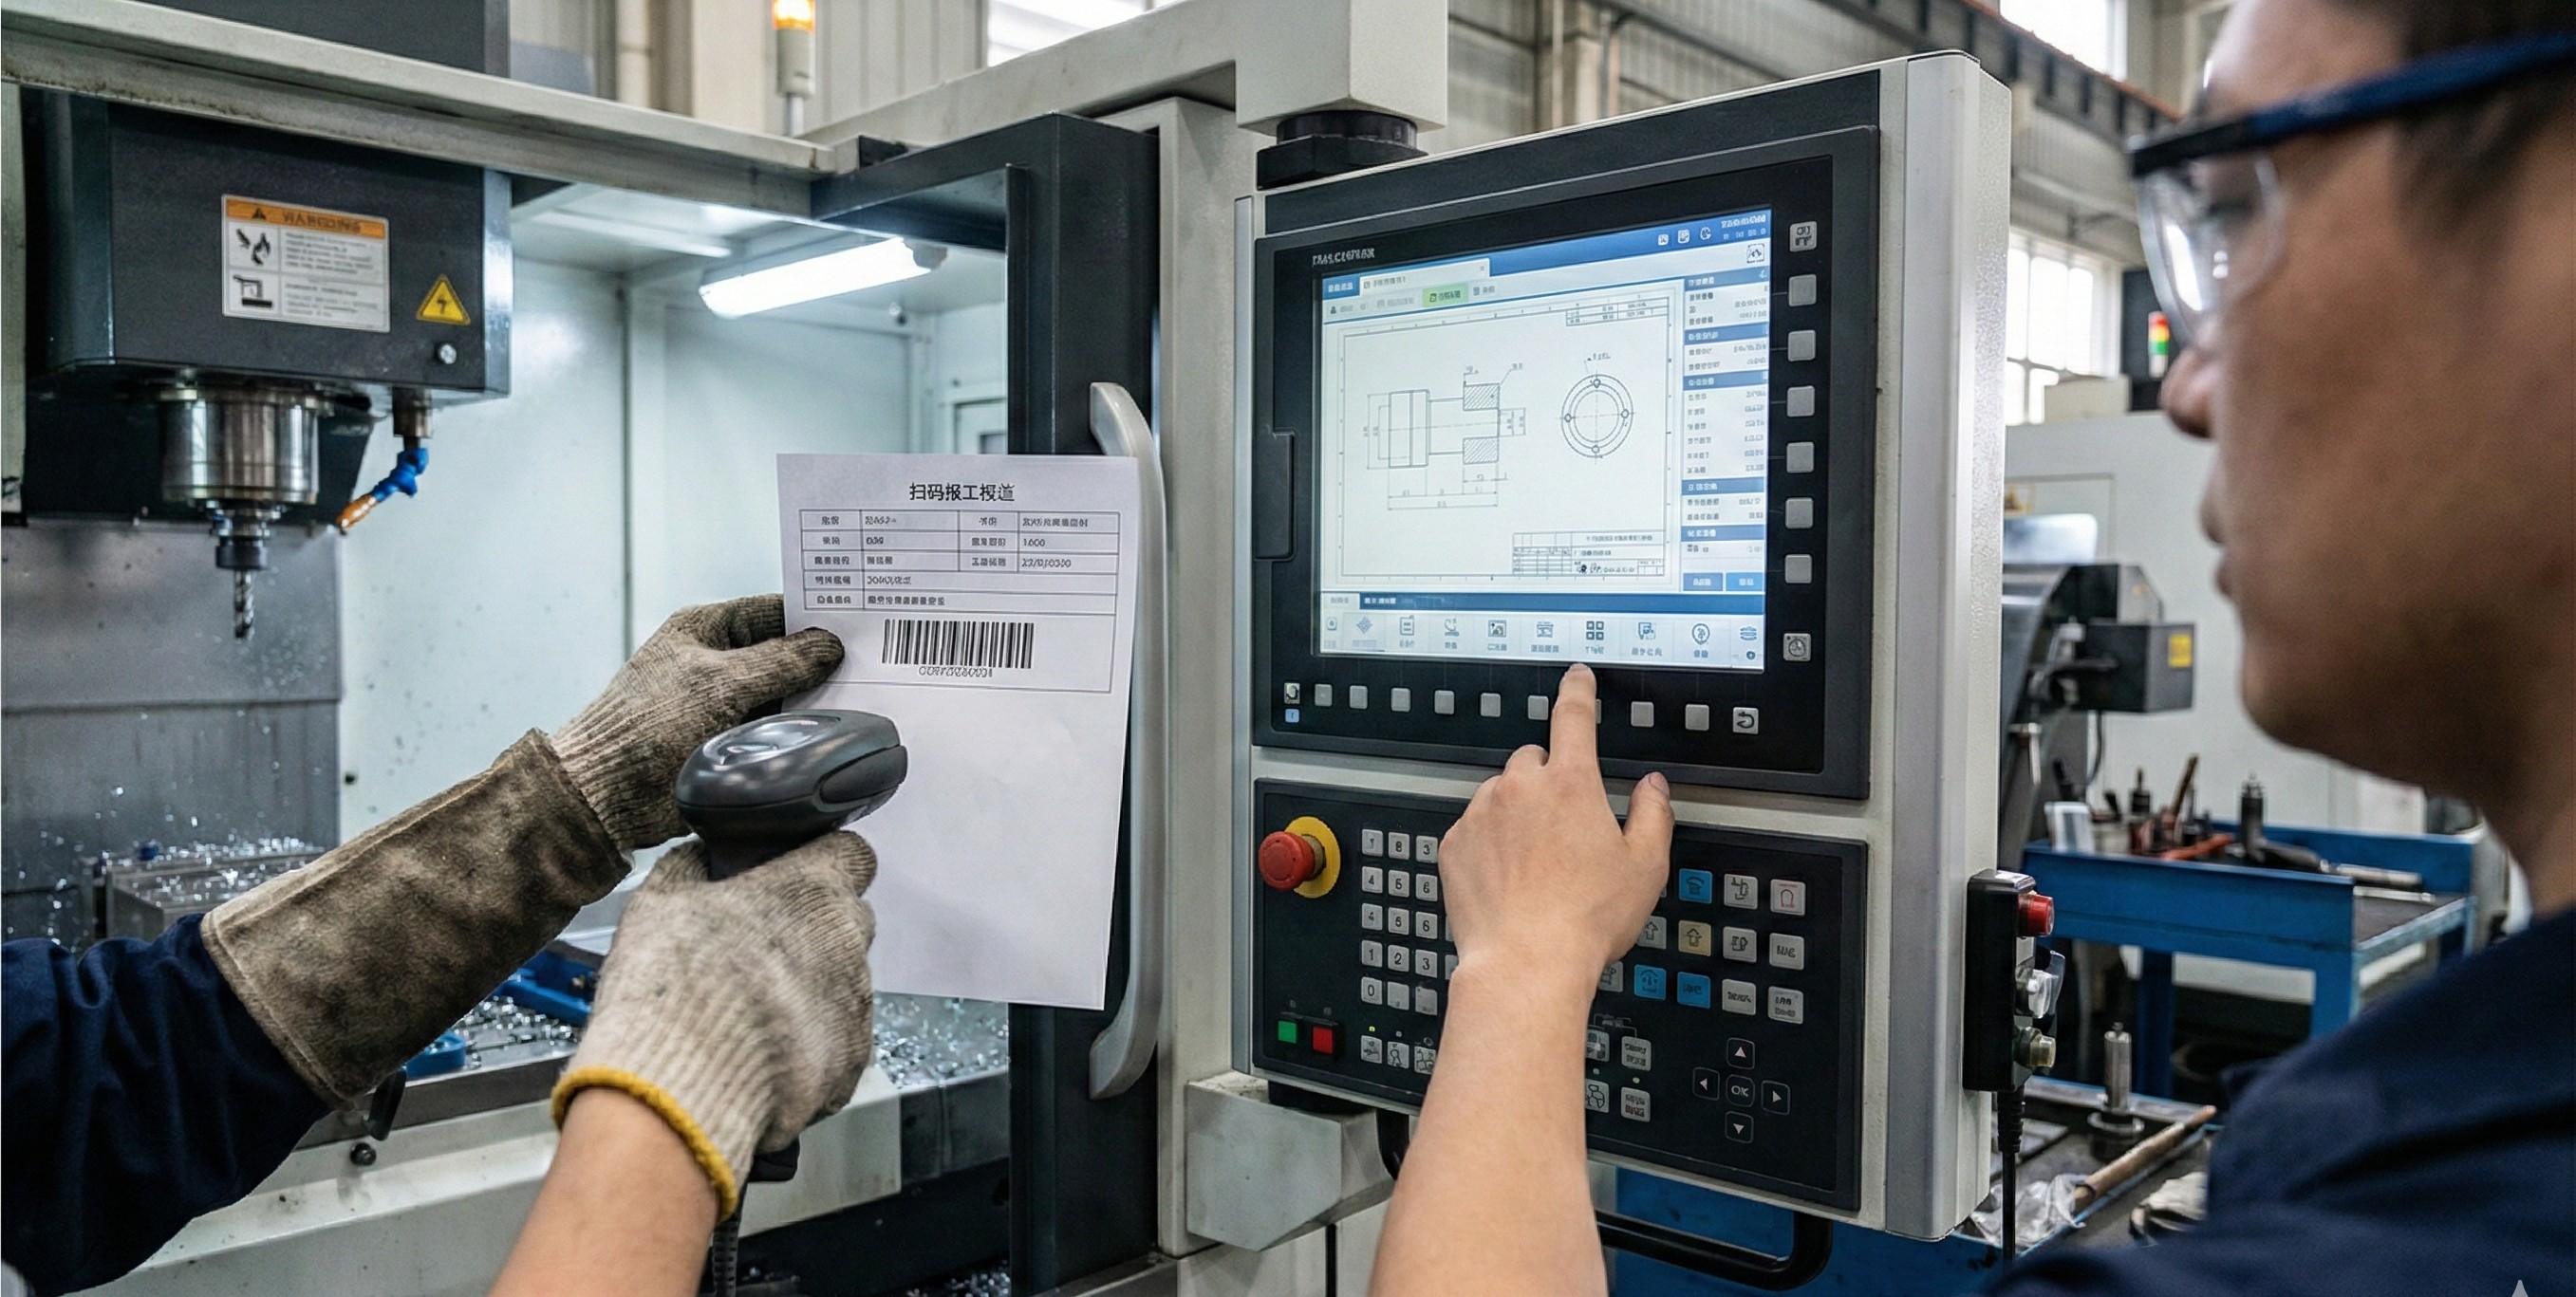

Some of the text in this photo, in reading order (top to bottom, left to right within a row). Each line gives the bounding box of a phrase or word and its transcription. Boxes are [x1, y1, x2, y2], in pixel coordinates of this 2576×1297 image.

[1423, 919, 1430, 932] 6
[1369, 948, 1430, 970] 1 2 3
[1367, 984, 1375, 997] 0
[1730, 1084, 1749, 1098] OK
